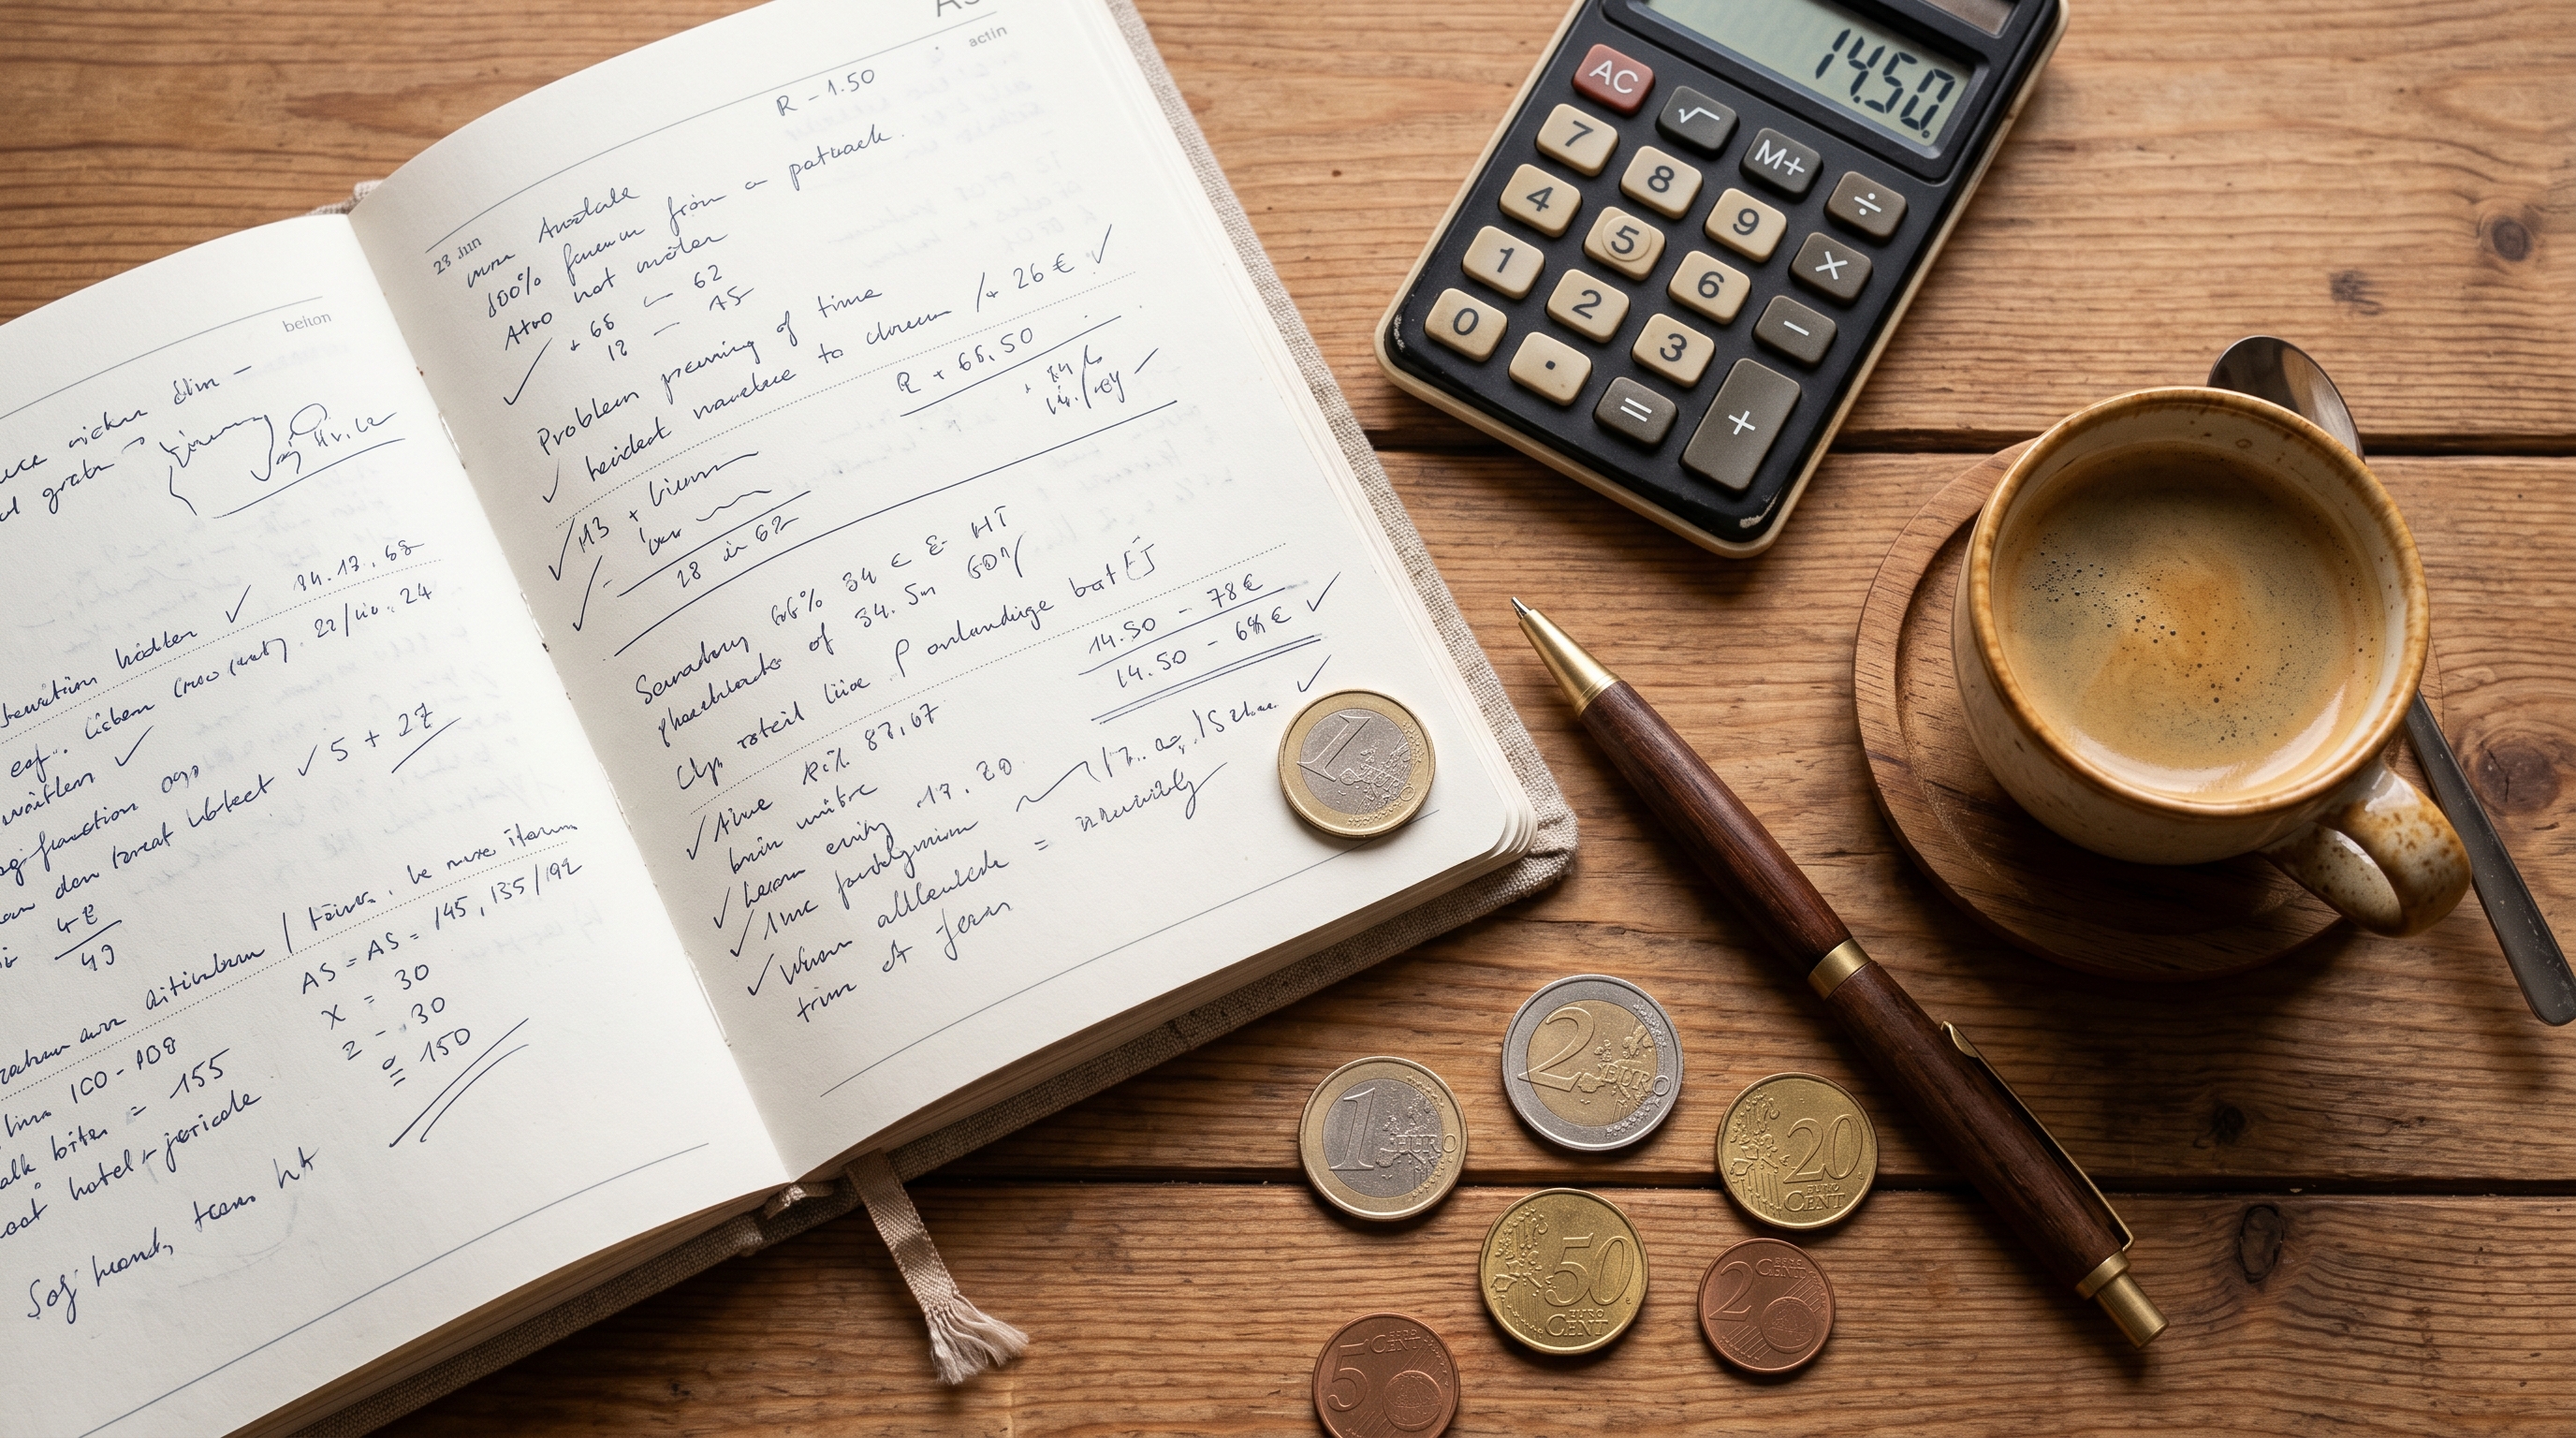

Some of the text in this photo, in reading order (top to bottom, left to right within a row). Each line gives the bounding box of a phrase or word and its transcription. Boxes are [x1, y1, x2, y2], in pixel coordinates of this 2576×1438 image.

[1589, 60, 1638, 95] AC
[1754, 139, 1805, 176] M+
[1564, 120, 1594, 147] 7
[1647, 165, 1675, 193] 8
[1733, 208, 1760, 236] 9
[1526, 187, 1554, 213] 4
[1610, 225, 1639, 254] 5
[1697, 271, 1724, 299] 6
[1453, 308, 1479, 336] 0
[1498, 247, 1514, 273] 1
[1573, 289, 1602, 319] 2
[1660, 333, 1688, 362] 3
[1296, 714, 1371, 782] 1
[1517, 1006, 1595, 1093] 2
[1329, 1088, 1375, 1170] 1
[1783, 1114, 1863, 1183] 20
[1784, 1191, 1845, 1212] CENT
[1544, 1233, 1634, 1307] 50
[1708, 1260, 1754, 1322] 2
[1545, 1313, 1608, 1336] CENT
[1327, 1339, 1368, 1412] 5
